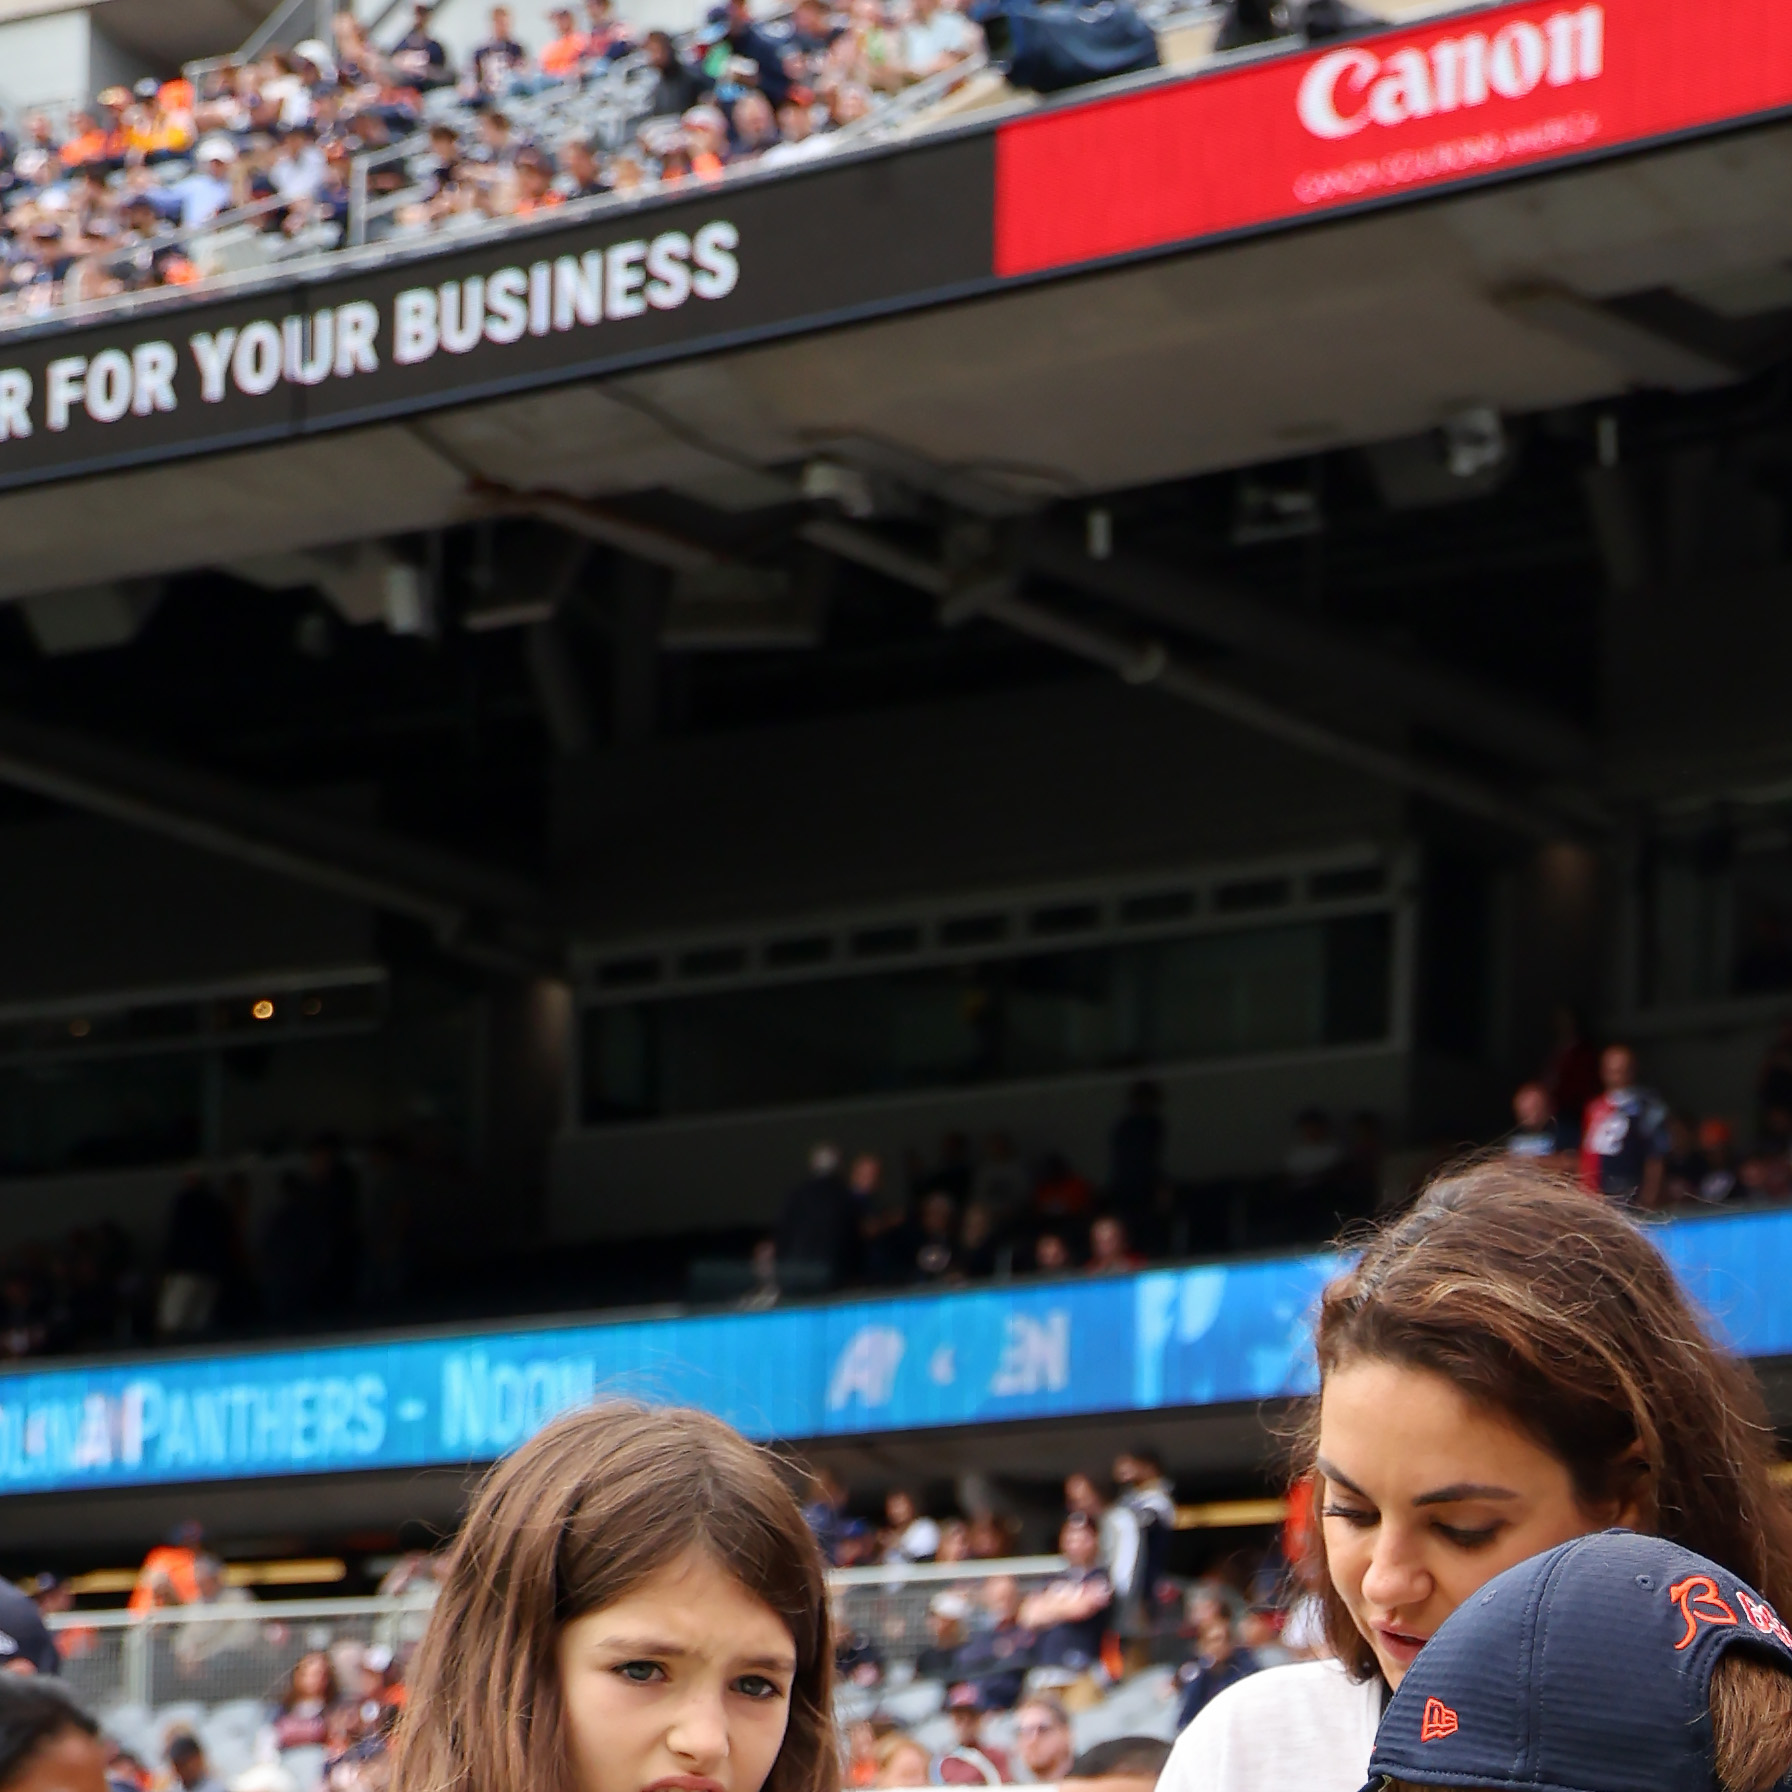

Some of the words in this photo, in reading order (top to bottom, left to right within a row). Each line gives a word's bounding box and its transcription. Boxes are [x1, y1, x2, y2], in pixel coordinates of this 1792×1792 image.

[1296, 4, 1605, 139] Canon
[46, 356, 178, 432] FOR
[190, 301, 380, 403] YOUR
[393, 220, 740, 366] BUSINESS
